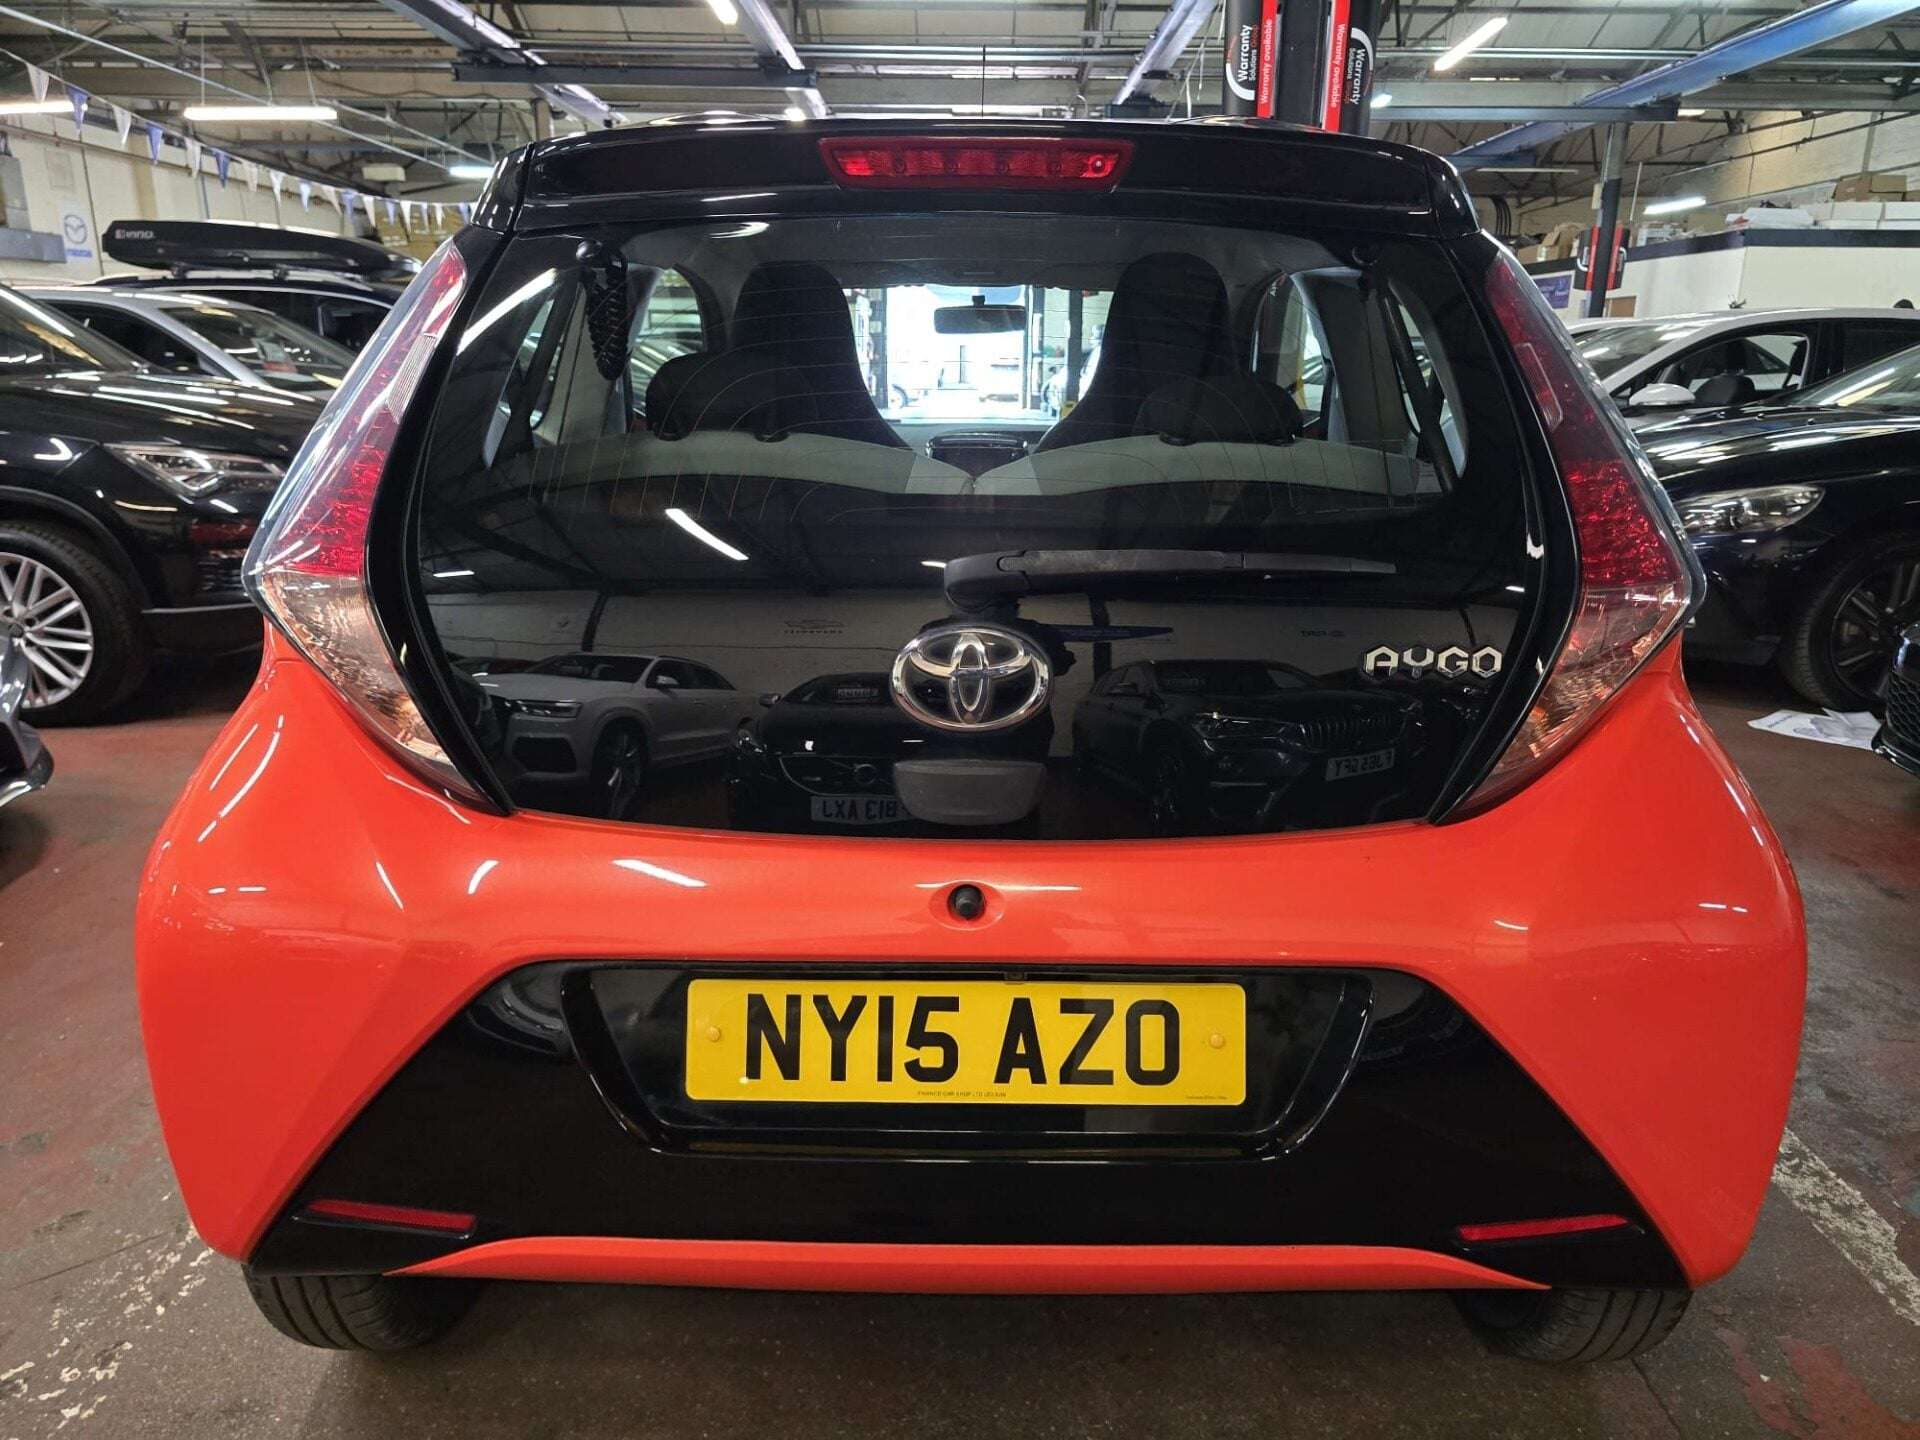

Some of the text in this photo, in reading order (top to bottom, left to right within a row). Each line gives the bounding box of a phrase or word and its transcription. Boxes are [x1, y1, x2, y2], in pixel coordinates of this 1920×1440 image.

[1237, 25, 1253, 82] Warranty
[1249, 49, 1258, 81] Solutions
[1261, 19, 1273, 104] Warranty available
[1330, 24, 1345, 109] Warranty available
[1346, 47, 1356, 80] Solutions
[1350, 47, 1366, 105] Warranty
[1364, 645, 1503, 680] AYGO
[745, 992, 1181, 1087] NY15 AZO
